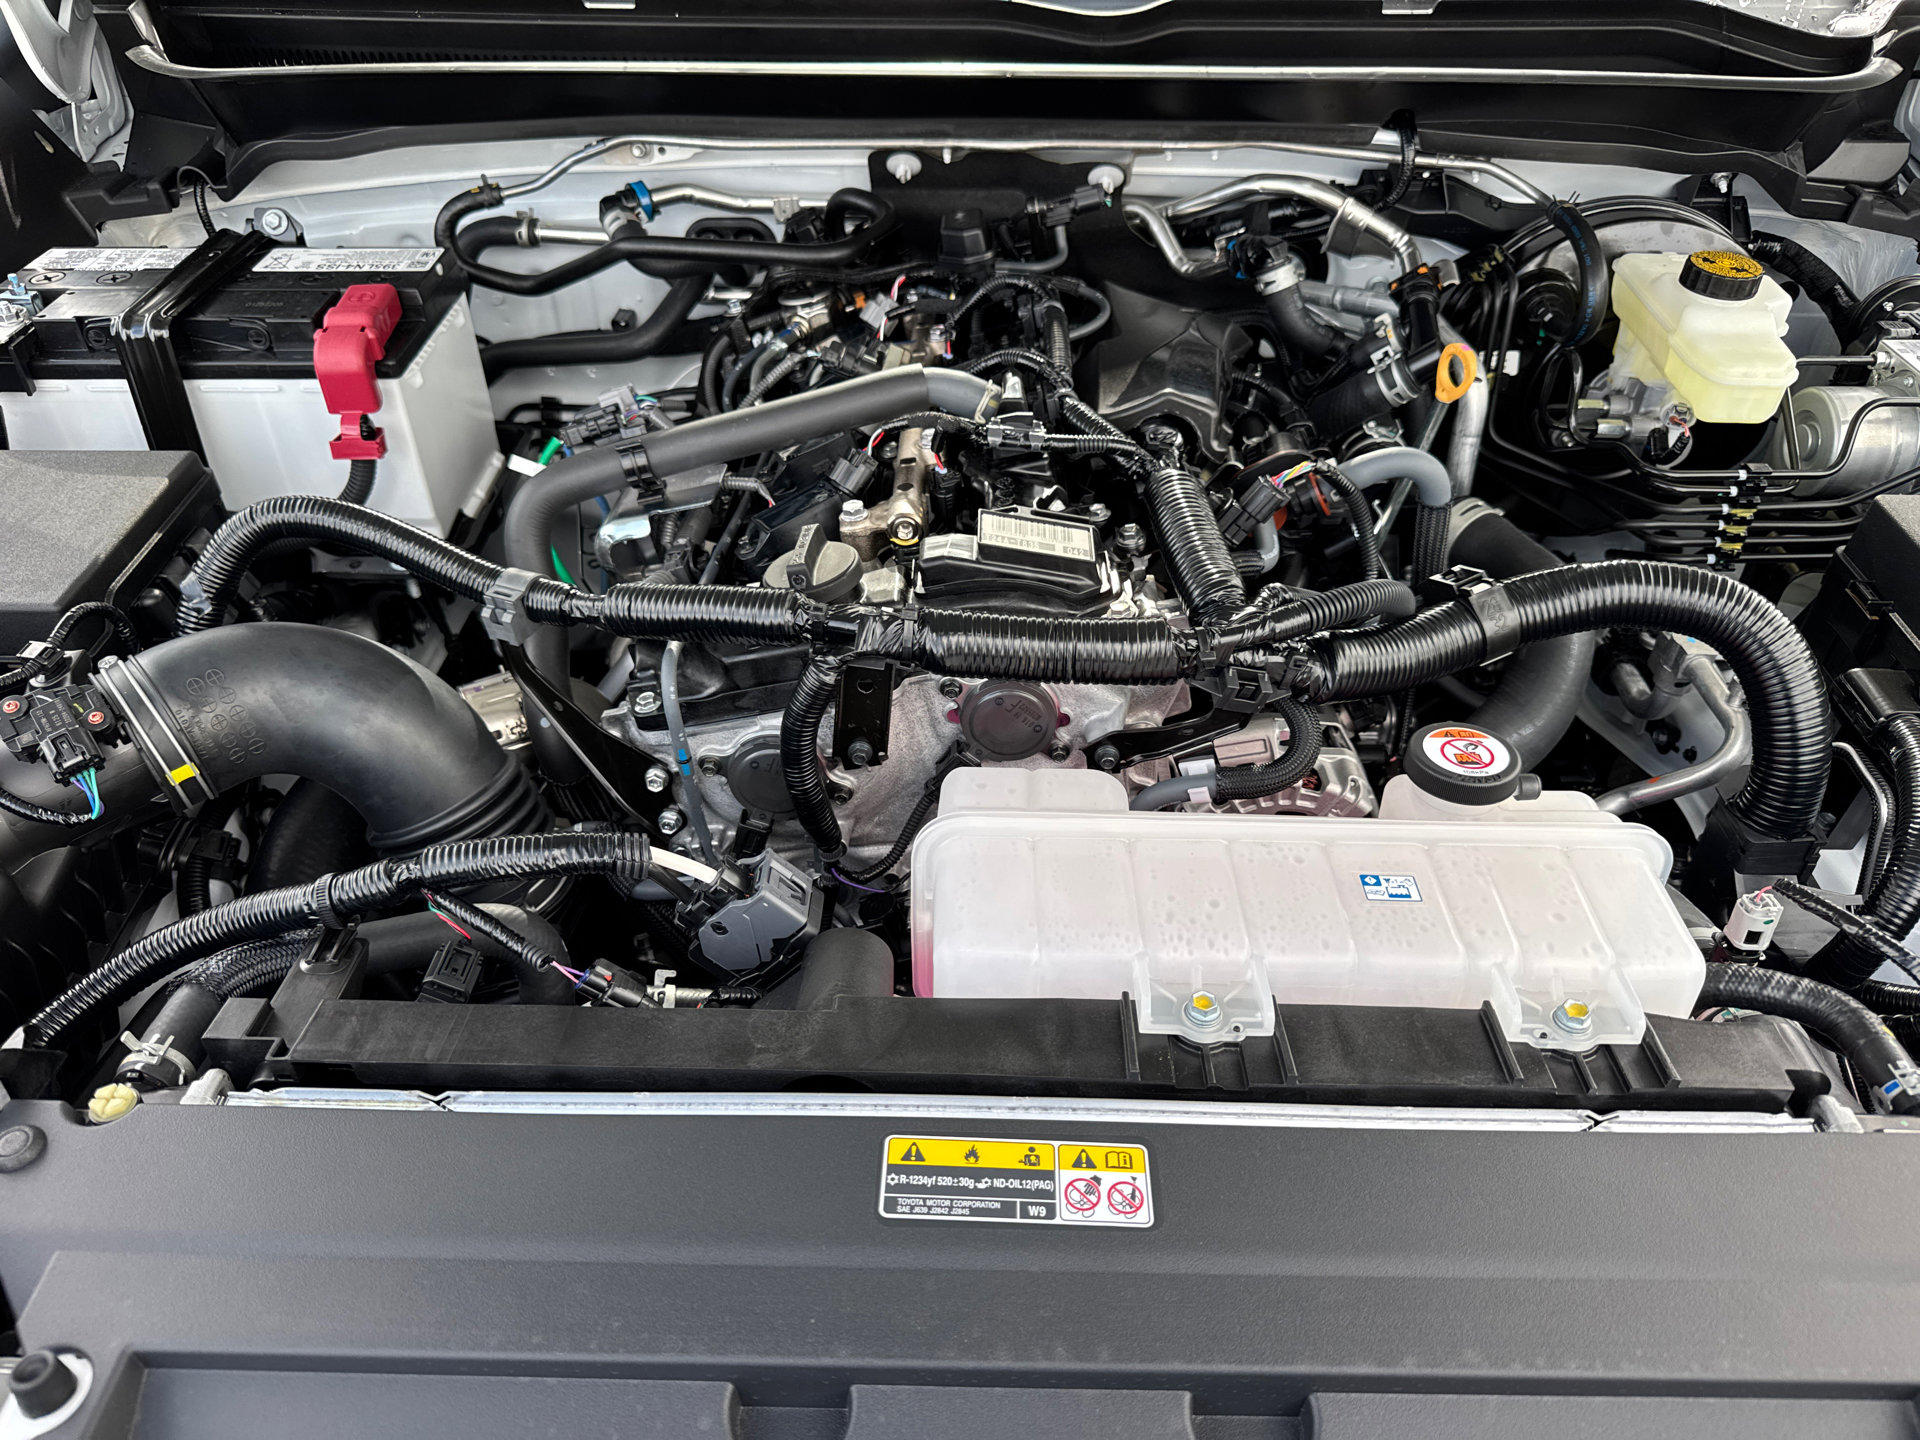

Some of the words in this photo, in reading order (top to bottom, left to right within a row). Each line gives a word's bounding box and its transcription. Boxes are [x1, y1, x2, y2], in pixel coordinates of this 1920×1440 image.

[900, 1175, 936, 1187] R-1234yf
[937, 1176, 974, 1189] 520±30g
[993, 1178, 1054, 1192] ND-OIL12(PAG)
[897, 1198, 924, 1206] TOYOTA
[953, 1200, 1001, 1209] CORPORATION
[897, 1205, 911, 1213] SAE
[1028, 1205, 1046, 1217] W9
